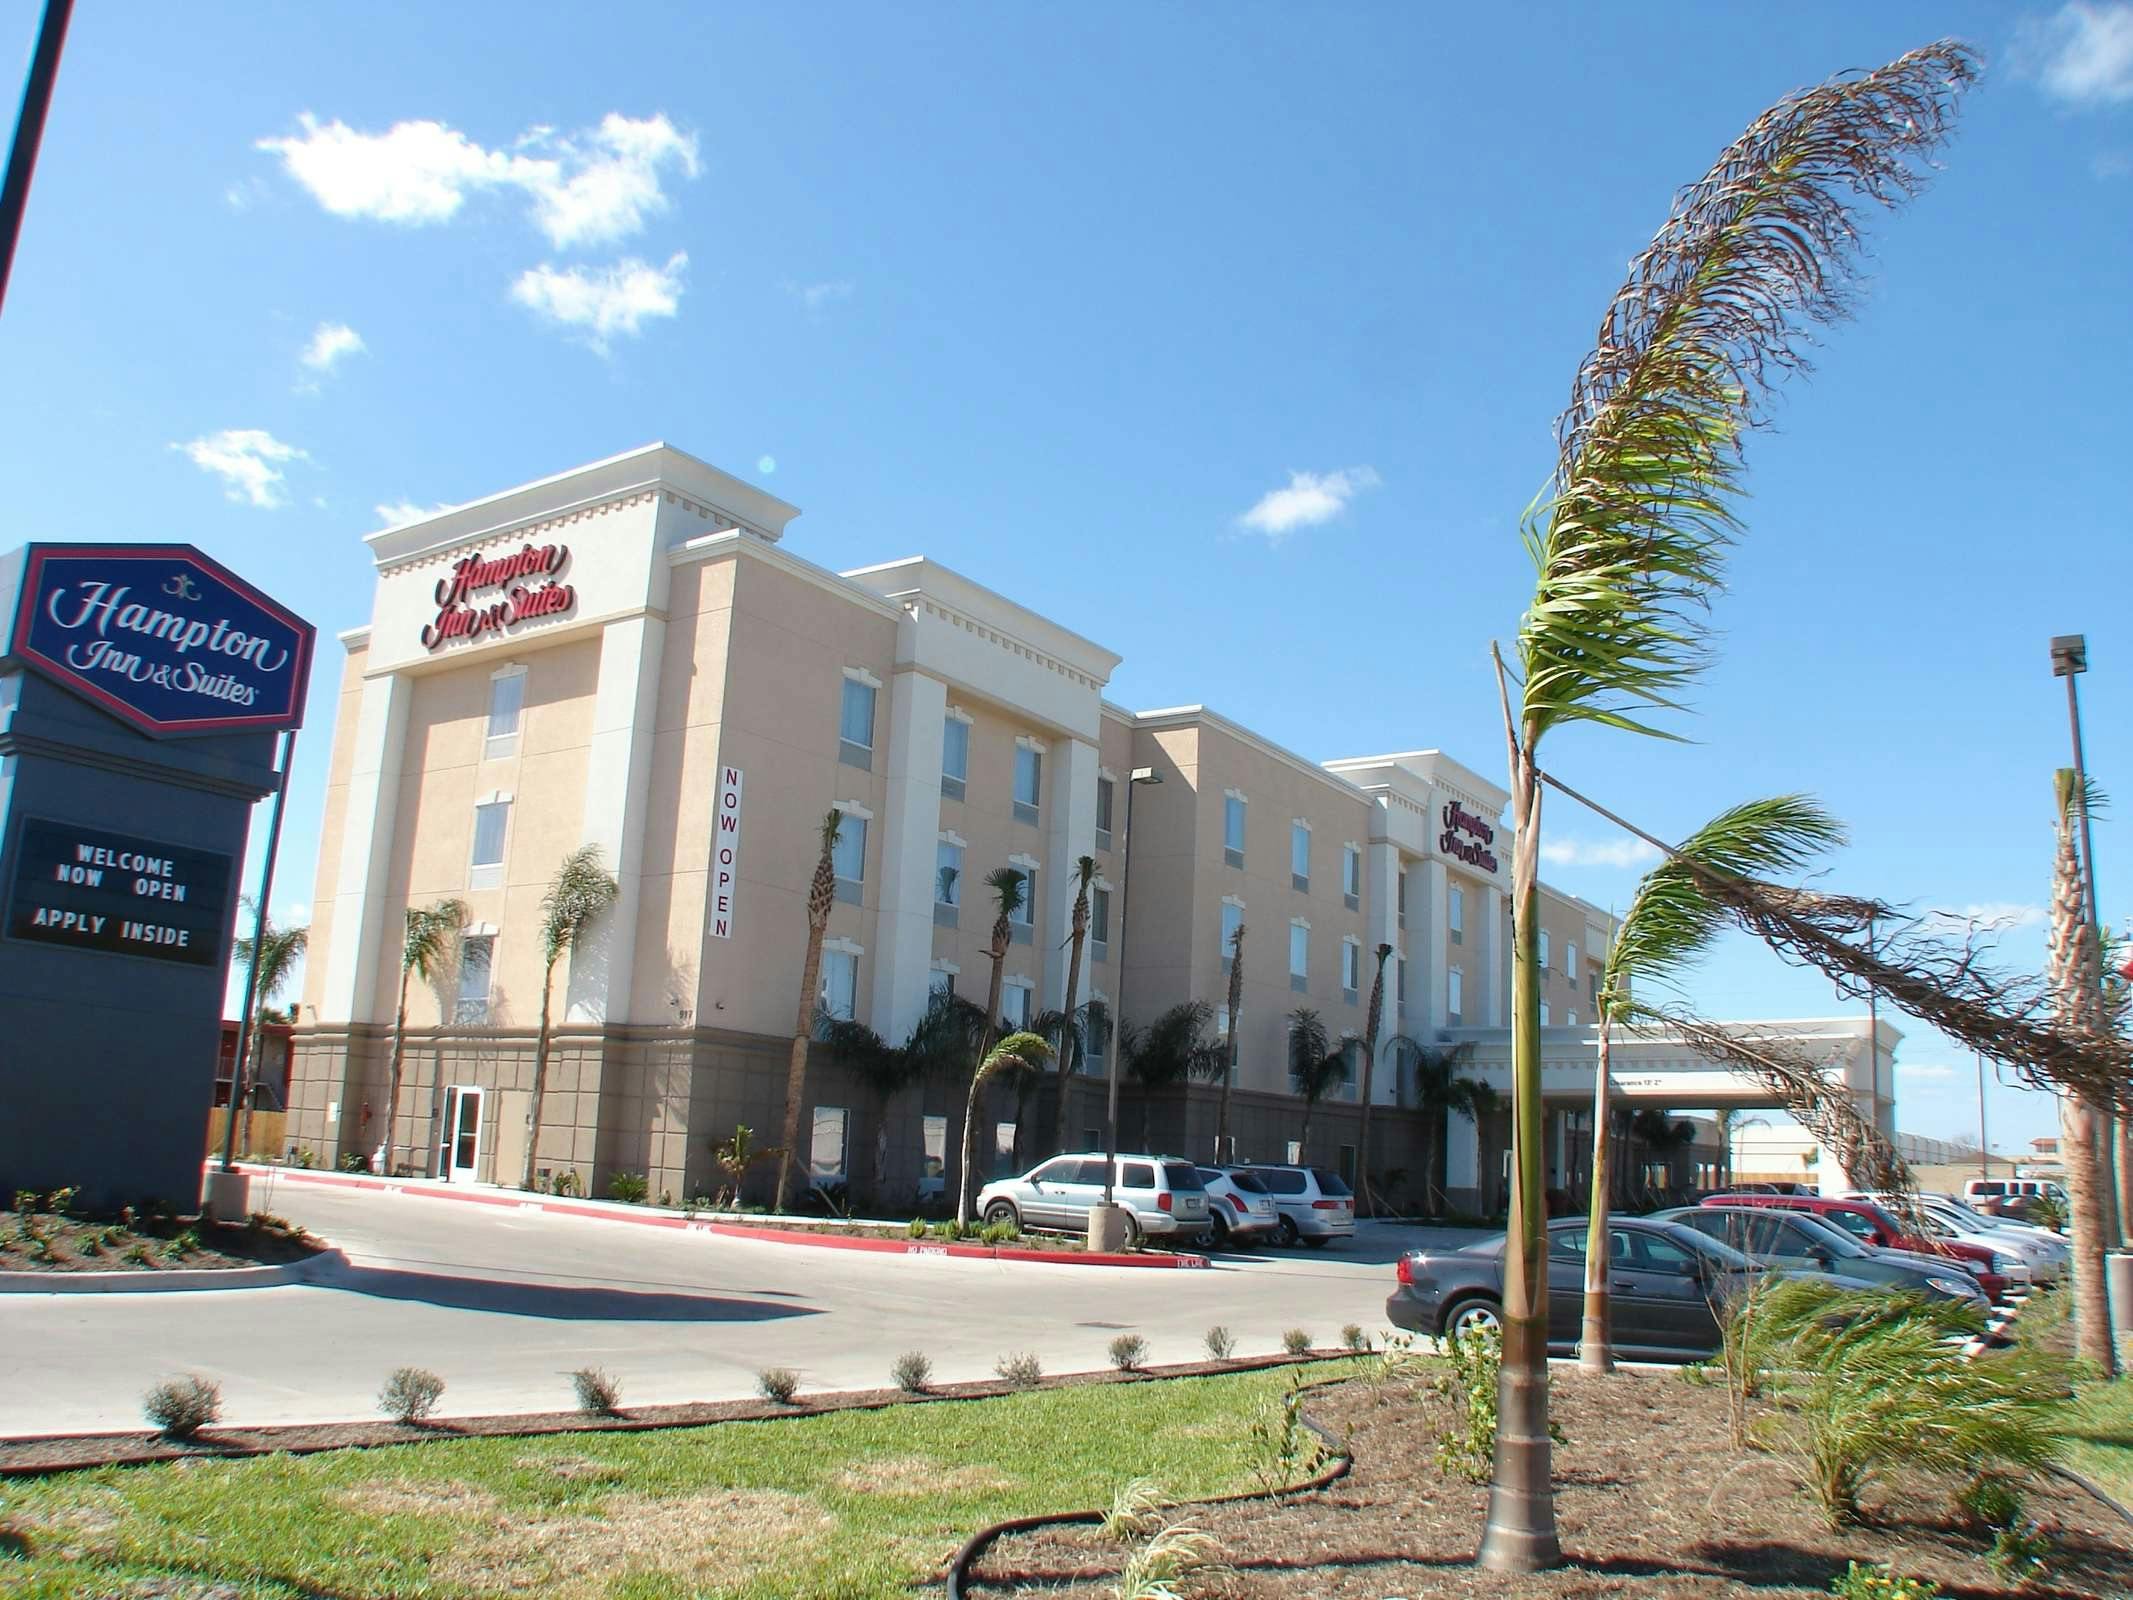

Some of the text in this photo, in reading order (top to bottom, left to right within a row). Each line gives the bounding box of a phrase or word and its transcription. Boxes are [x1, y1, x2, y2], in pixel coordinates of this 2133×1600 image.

[435, 543, 568, 608] Hampton
[49, 581, 288, 672] Hampton
[421, 604, 482, 649] Inn
[500, 580, 574, 626] Suites
[67, 640, 256, 706] Inn & Suites
[56, 863, 187, 903] NOW OPEN
[77, 843, 174, 878] WELCOME
[716, 768, 738, 936] NOW OPEN
[32, 907, 190, 948] APPLY INSIDE
